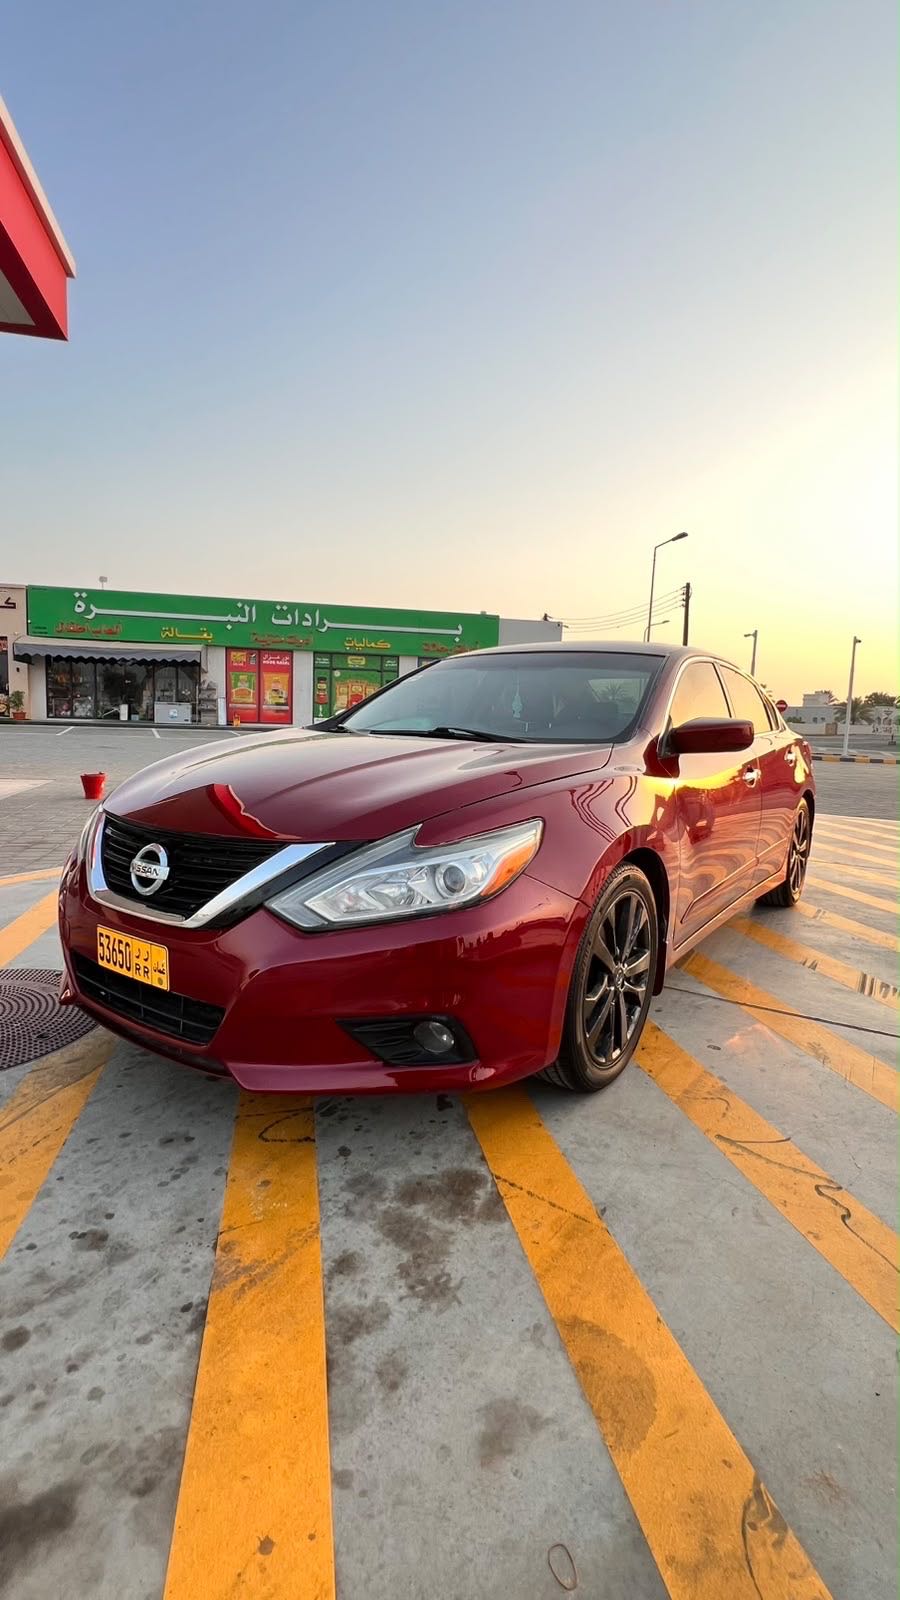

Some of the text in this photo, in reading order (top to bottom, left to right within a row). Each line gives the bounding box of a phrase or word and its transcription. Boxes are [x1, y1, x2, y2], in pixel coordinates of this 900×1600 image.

[73, 592, 463, 642] برادات النبرة
[160, 627, 213, 643] بقالة
[344, 637, 391, 650] كماليات
[131, 862, 159, 876] NISSAN
[99, 932, 131, 972] 53650
